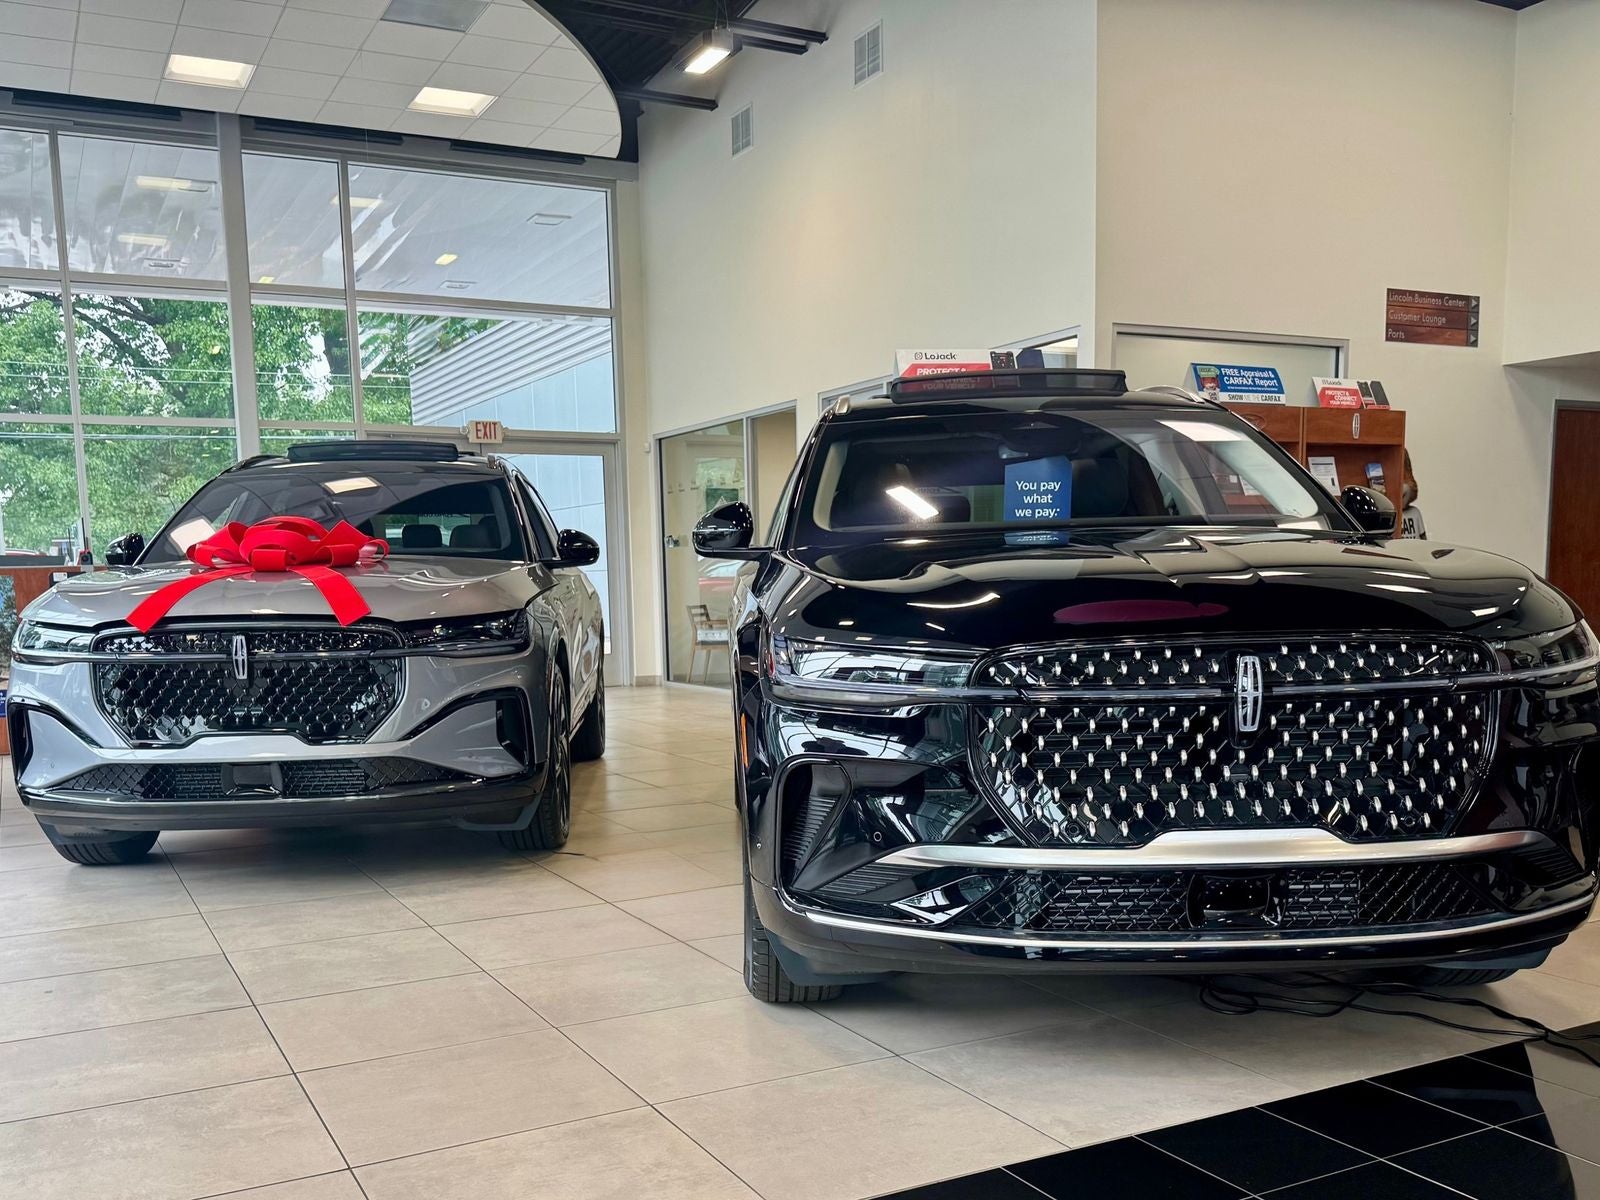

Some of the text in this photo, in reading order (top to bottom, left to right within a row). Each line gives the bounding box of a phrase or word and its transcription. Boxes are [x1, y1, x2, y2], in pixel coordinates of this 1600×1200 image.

[1389, 292, 1466, 307] Lincoln Business Center
[1388, 310, 1446, 325] Customer Lounge
[1387, 328, 1405, 339] Parts
[1221, 367, 1240, 377] FREE
[1223, 376, 1279, 387] CARFAX Report
[1227, 393, 1243, 401] SHOW
[1260, 394, 1281, 402] CARFAX
[475, 421, 497, 440] EXIT
[1015, 480, 1061, 492] You pay
[1023, 493, 1053, 503] what
[1015, 508, 1032, 517] we
[1401, 517, 1416, 535] AR
